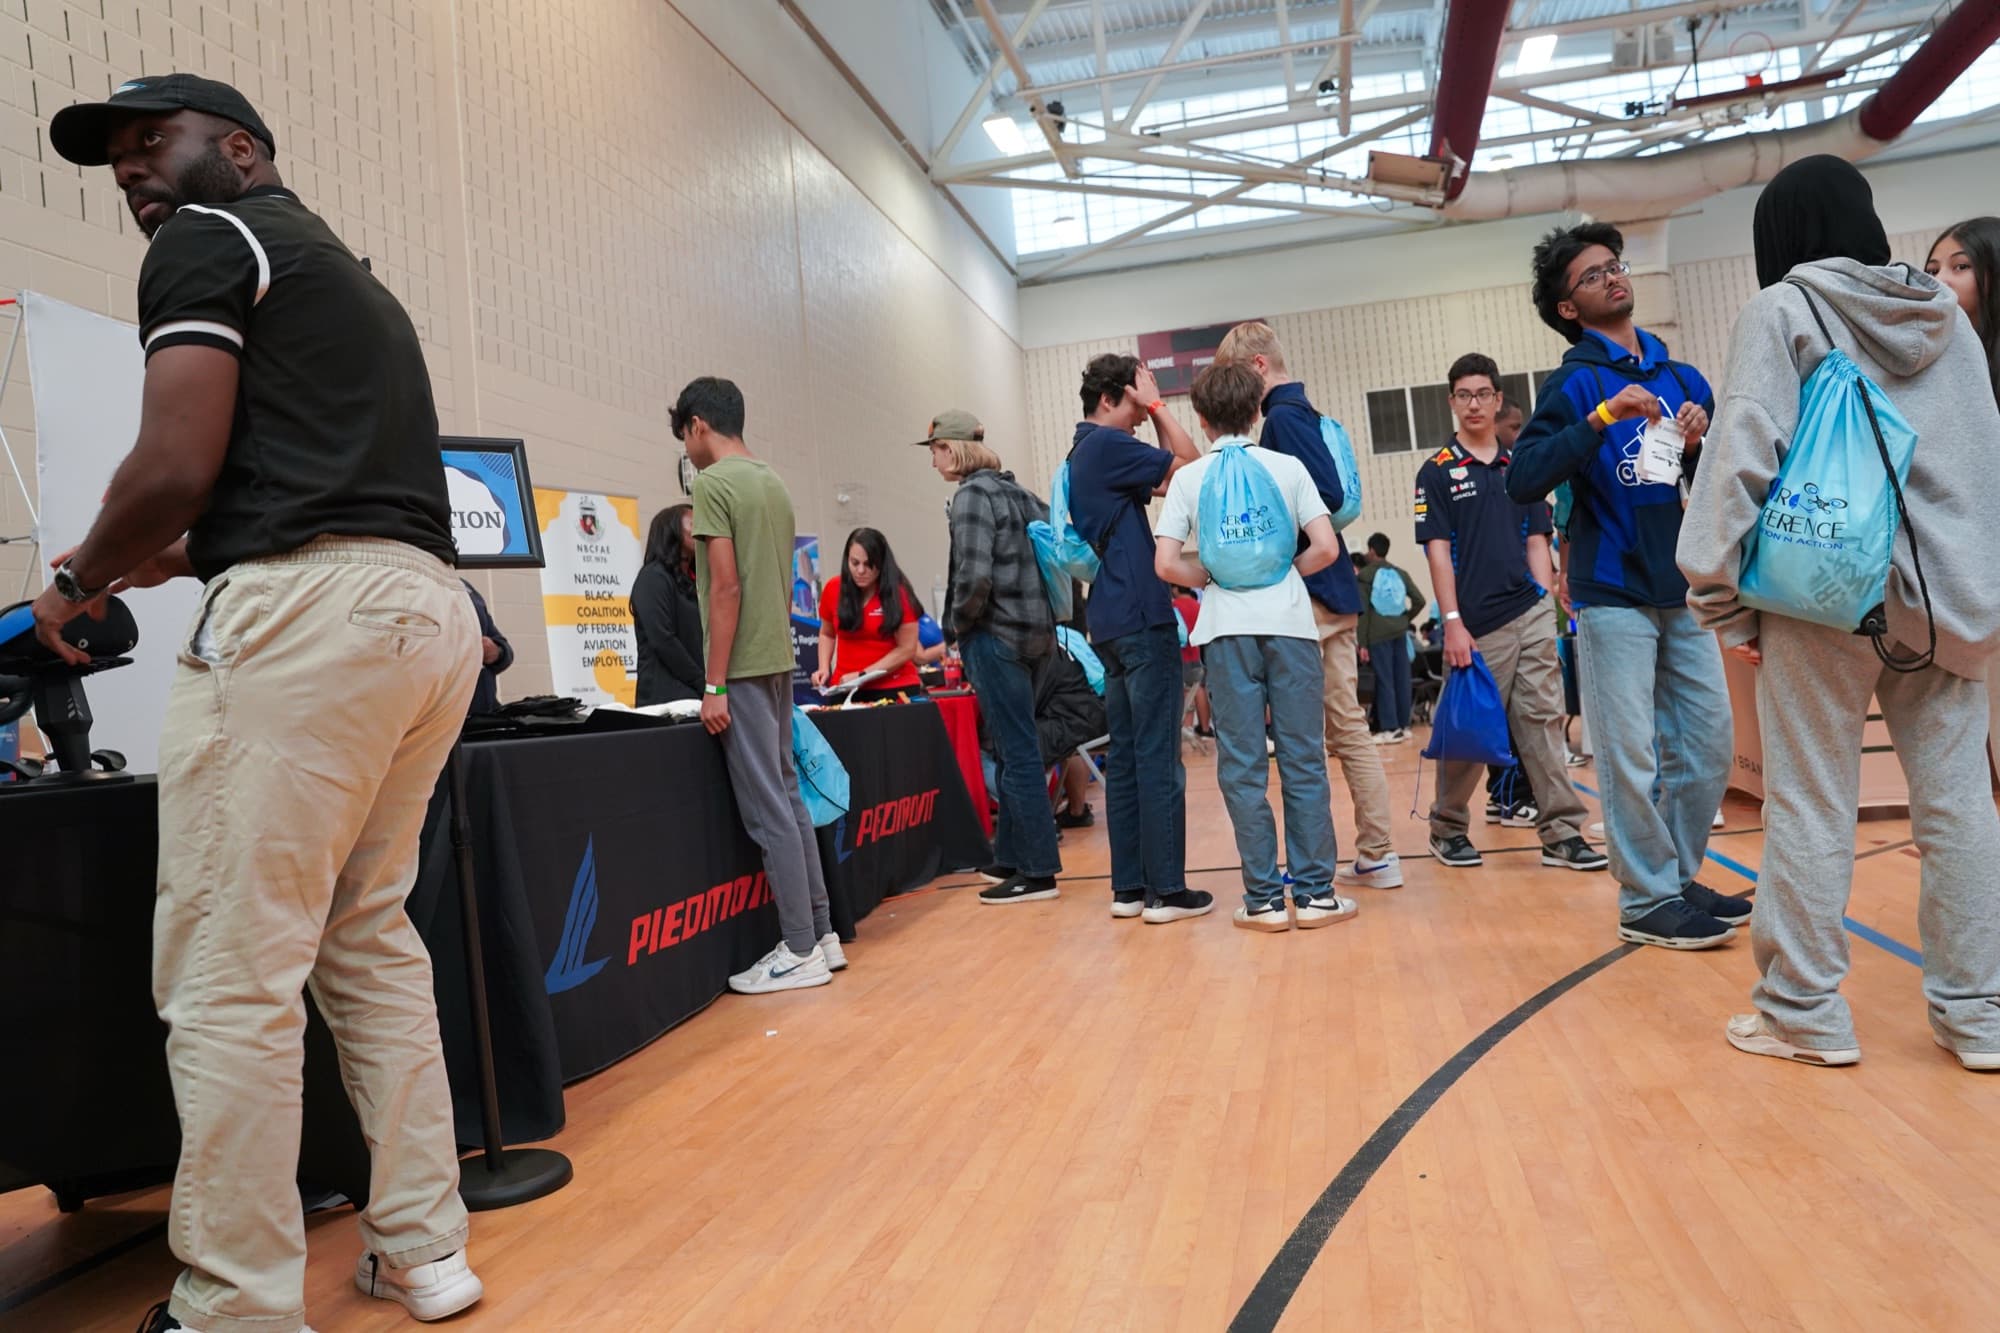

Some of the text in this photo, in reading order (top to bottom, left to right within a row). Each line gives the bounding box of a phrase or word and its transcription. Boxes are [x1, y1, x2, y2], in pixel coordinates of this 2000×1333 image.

[1796, 537, 1843, 550] ACTION
[574, 573, 621, 585] NATIONAL
[585, 590, 615, 601] BLACK
[577, 606, 626, 618] COALITION
[577, 624, 629, 634] OF FEDERAL
[584, 640, 626, 651] AVIATION
[582, 656, 634, 668] EMPLOYEES
[856, 788, 940, 848] PEDMONT
[627, 871, 776, 966] PIEDMON
